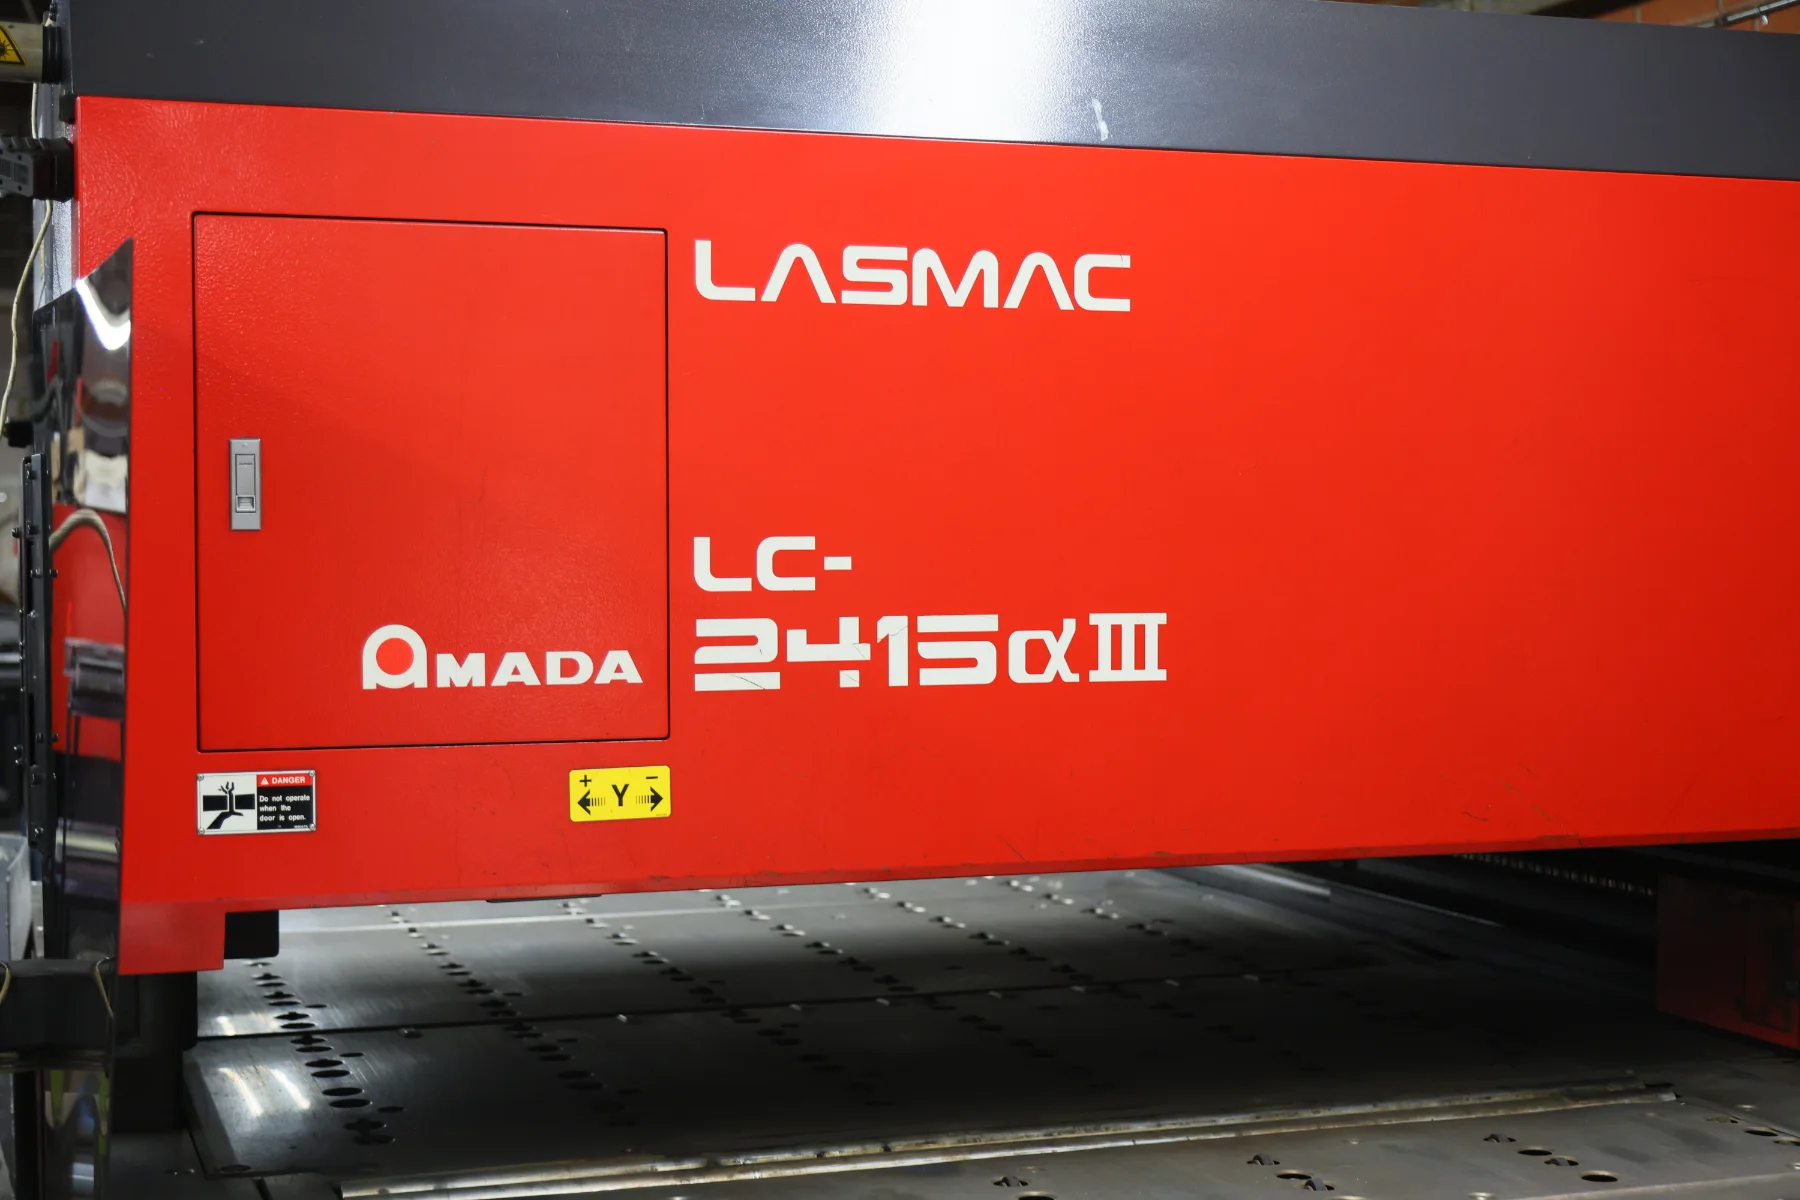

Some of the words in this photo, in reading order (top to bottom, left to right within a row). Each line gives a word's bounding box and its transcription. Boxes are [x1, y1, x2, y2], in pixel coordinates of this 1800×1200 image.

[695, 240, 1131, 312] LASMAC
[694, 535, 852, 593] LC-
[362, 624, 644, 690] AMADA
[271, 776, 306, 784] DANGER
[285, 794, 311, 802] operate
[611, 783, 630, 807] Y
[259, 814, 276, 822] door
[288, 814, 307, 822] open.
